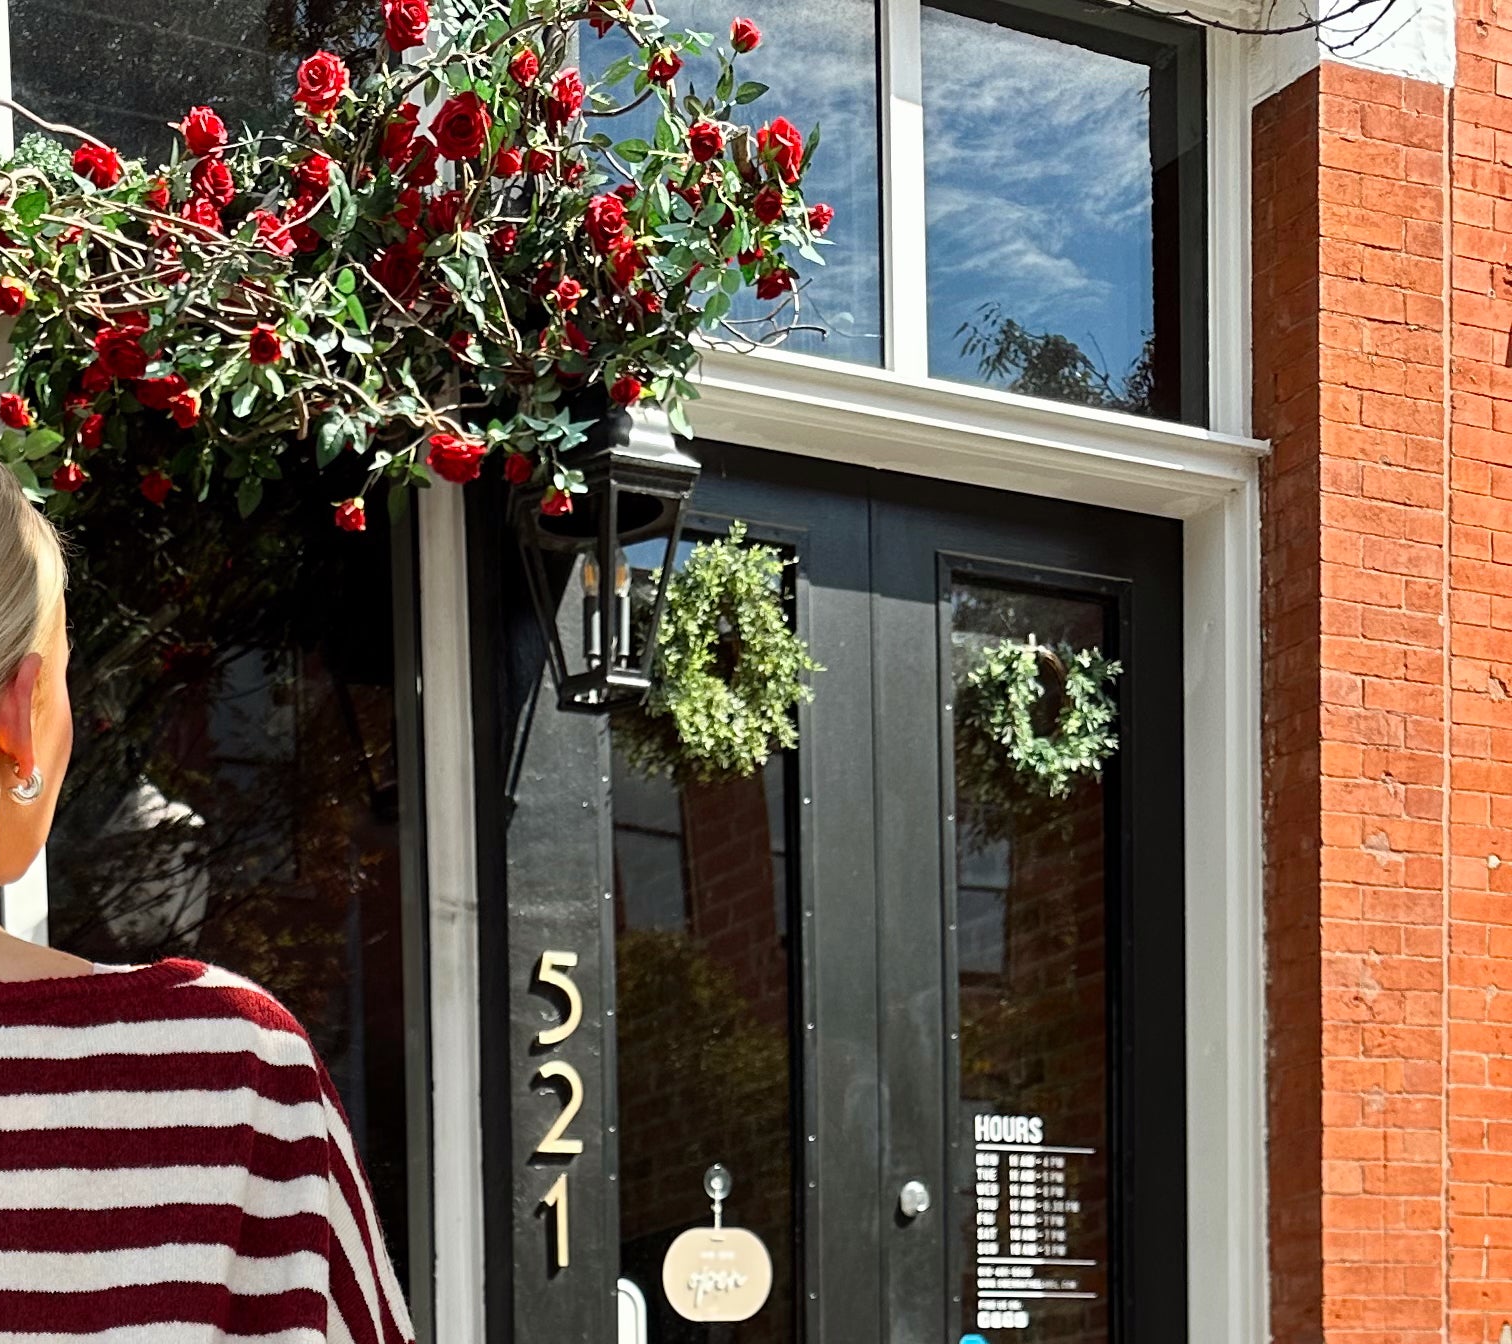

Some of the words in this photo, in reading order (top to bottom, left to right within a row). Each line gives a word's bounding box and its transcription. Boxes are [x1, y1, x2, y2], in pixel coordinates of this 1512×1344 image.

[538, 950, 584, 1268] 521
[974, 1114, 1044, 1144] HOURS
[687, 1266, 749, 1308] open
